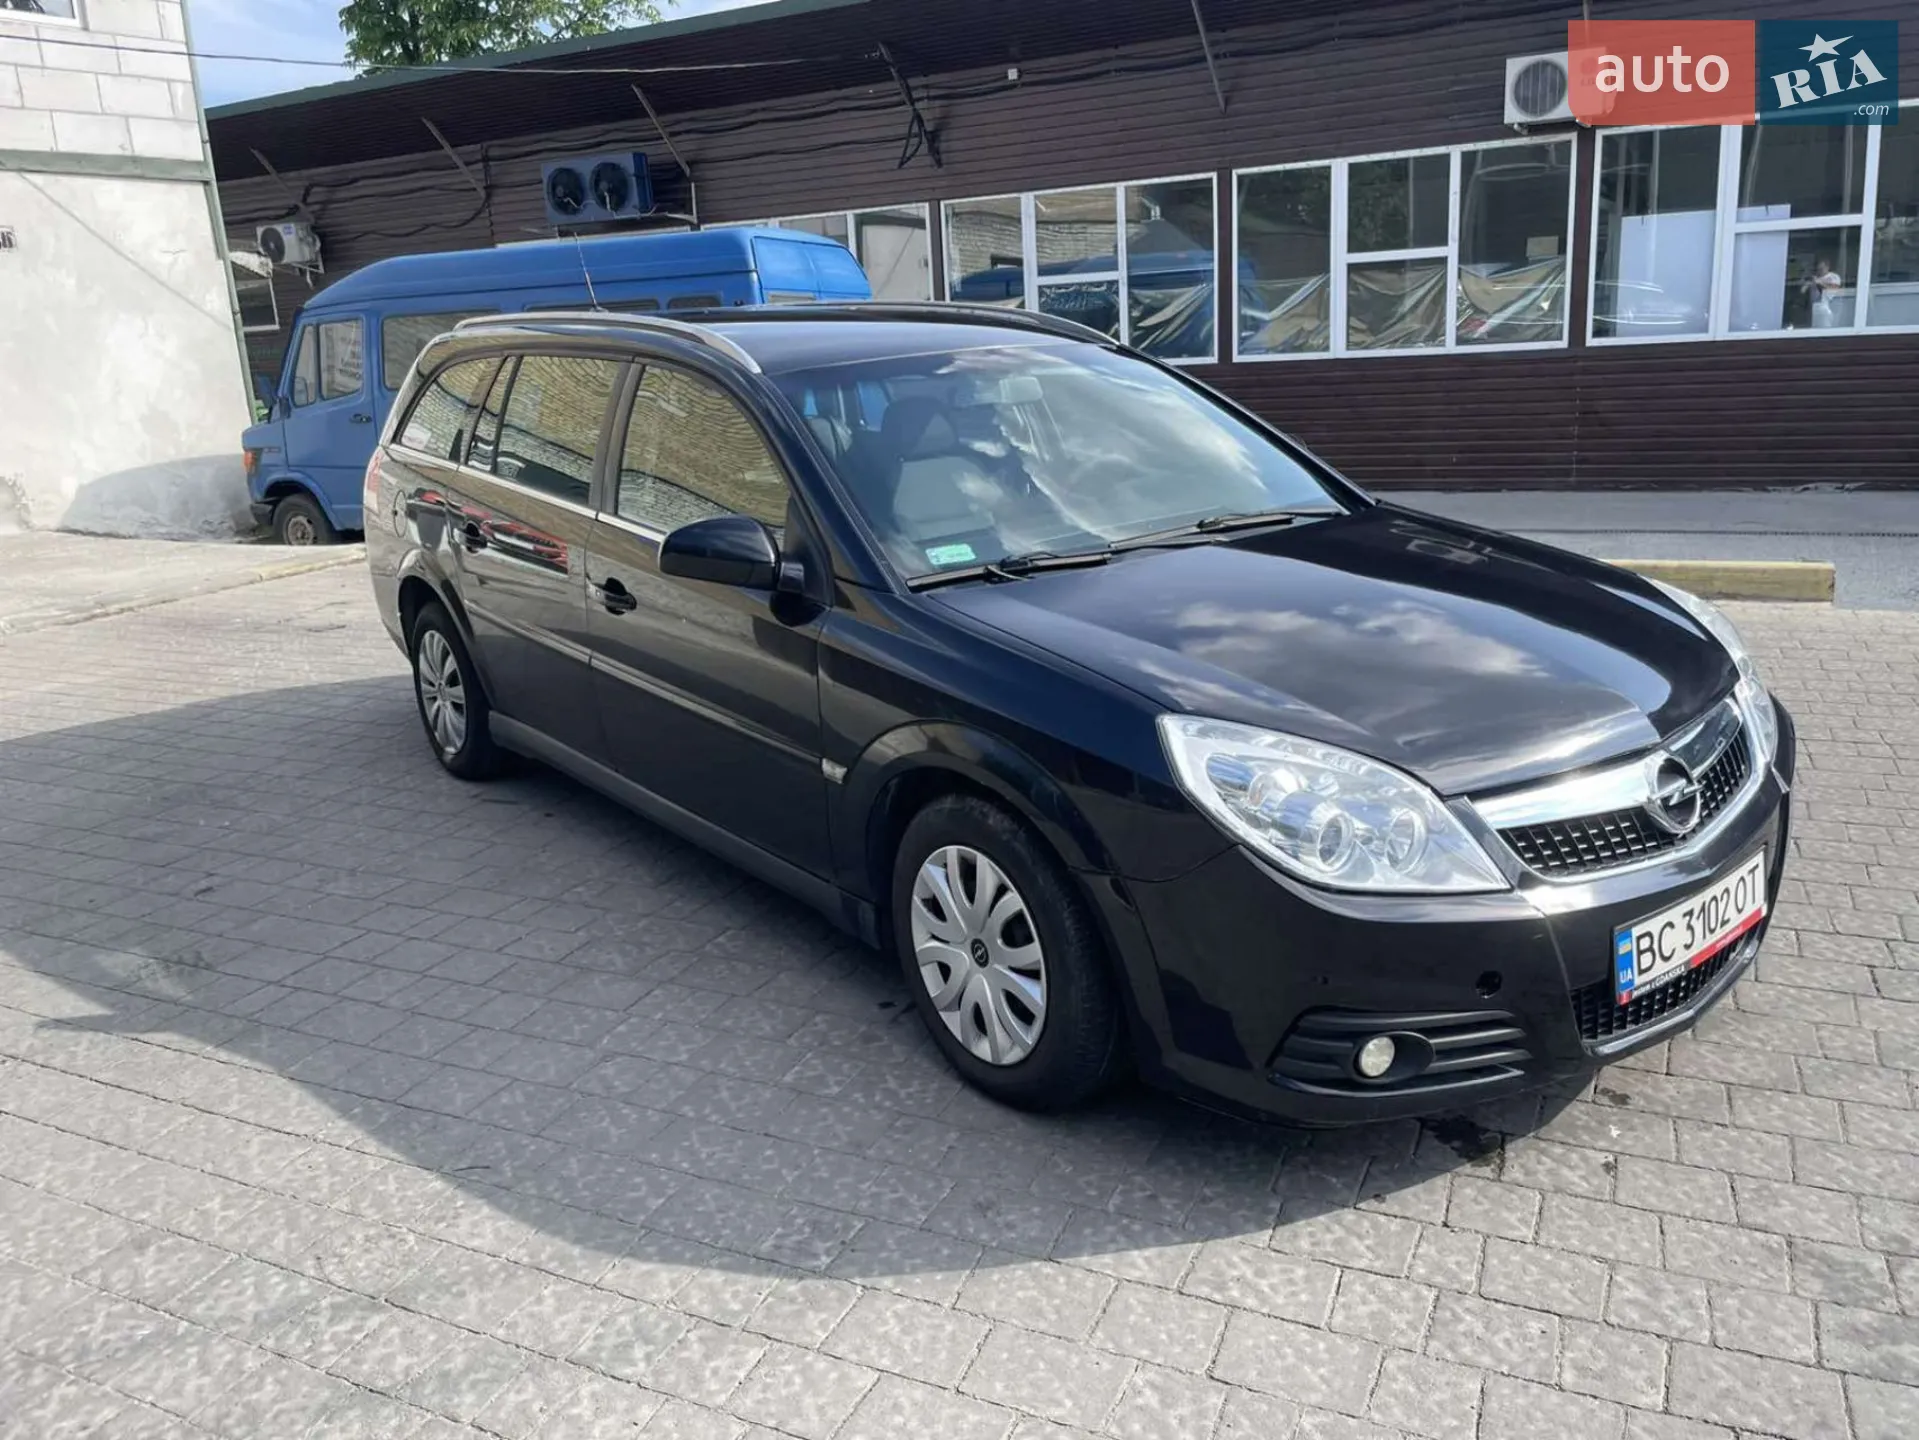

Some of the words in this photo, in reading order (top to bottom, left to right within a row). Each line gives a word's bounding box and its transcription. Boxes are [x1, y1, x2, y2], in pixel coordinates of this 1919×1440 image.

[1636, 921, 1676, 976] BC
[1682, 887, 1730, 950] 3102
[1735, 864, 1760, 914] OT
[1619, 967, 1633, 983] UA
